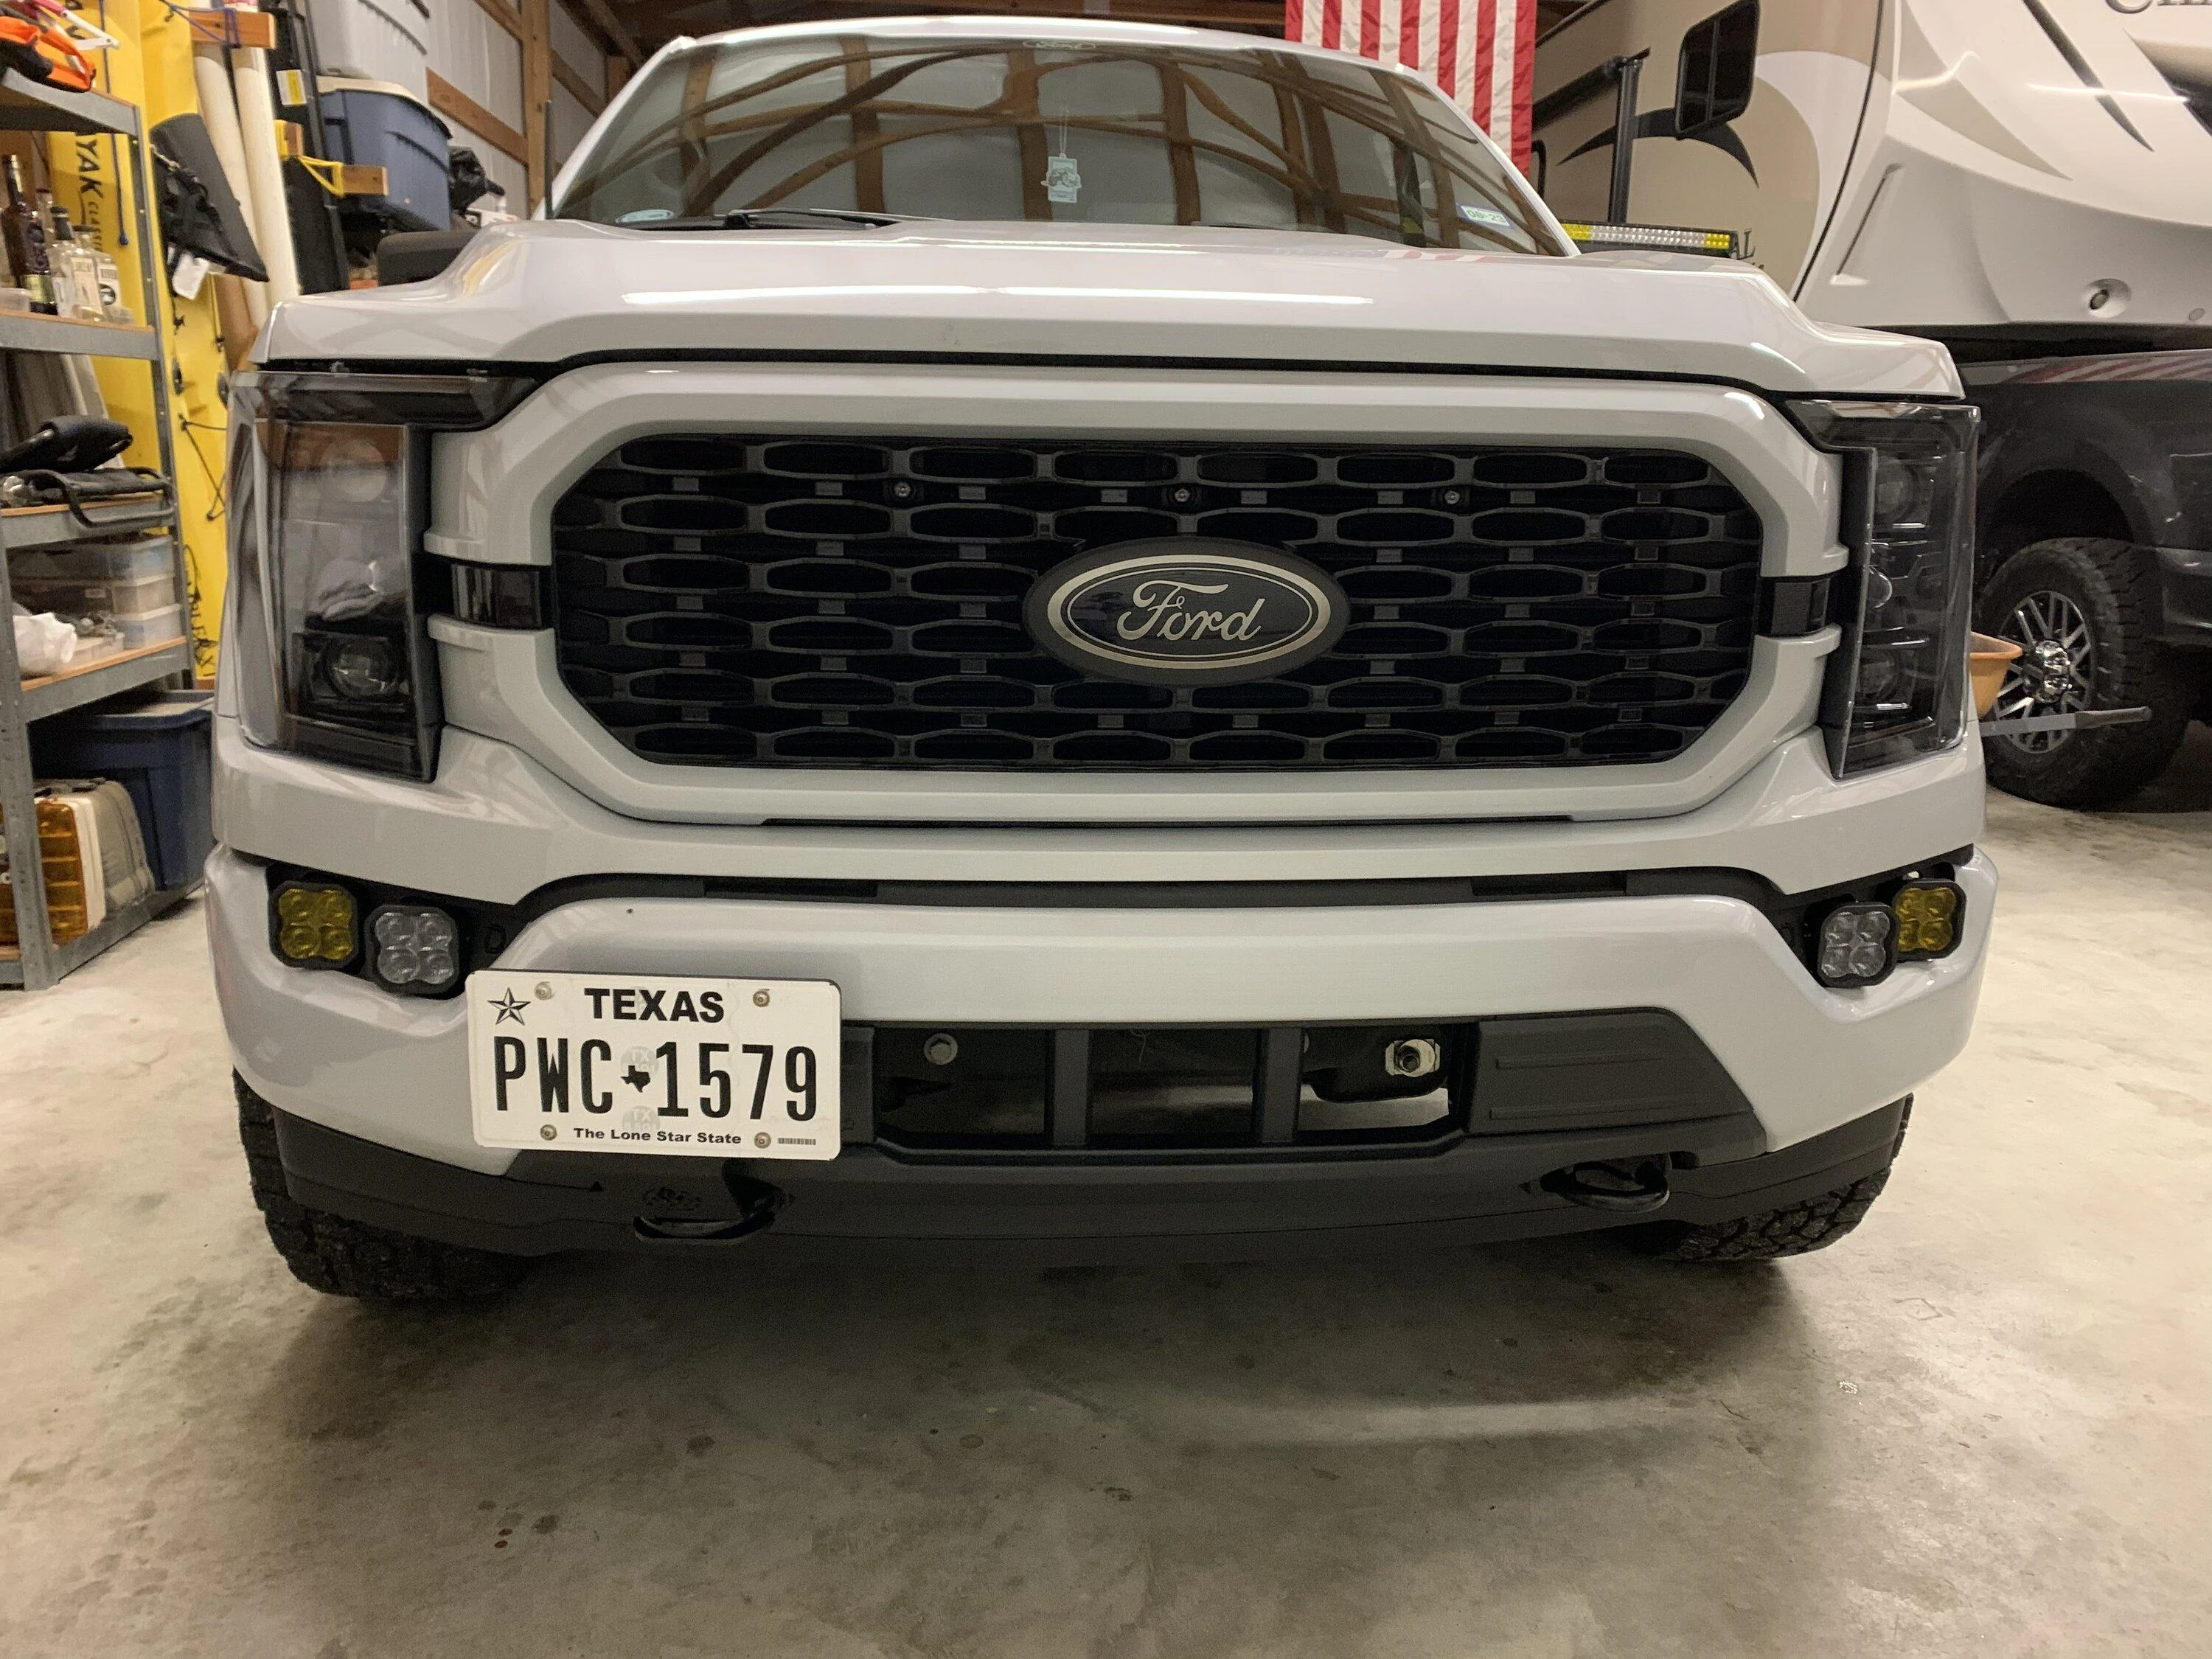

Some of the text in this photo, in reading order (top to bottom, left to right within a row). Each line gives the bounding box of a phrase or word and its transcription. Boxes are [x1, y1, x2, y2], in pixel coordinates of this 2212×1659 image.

[1116, 580, 1266, 641] Ford
[585, 988, 724, 1023] TEXAS
[494, 1036, 817, 1121] PWC 1579
[574, 1127, 742, 1144] The Lone Star State
